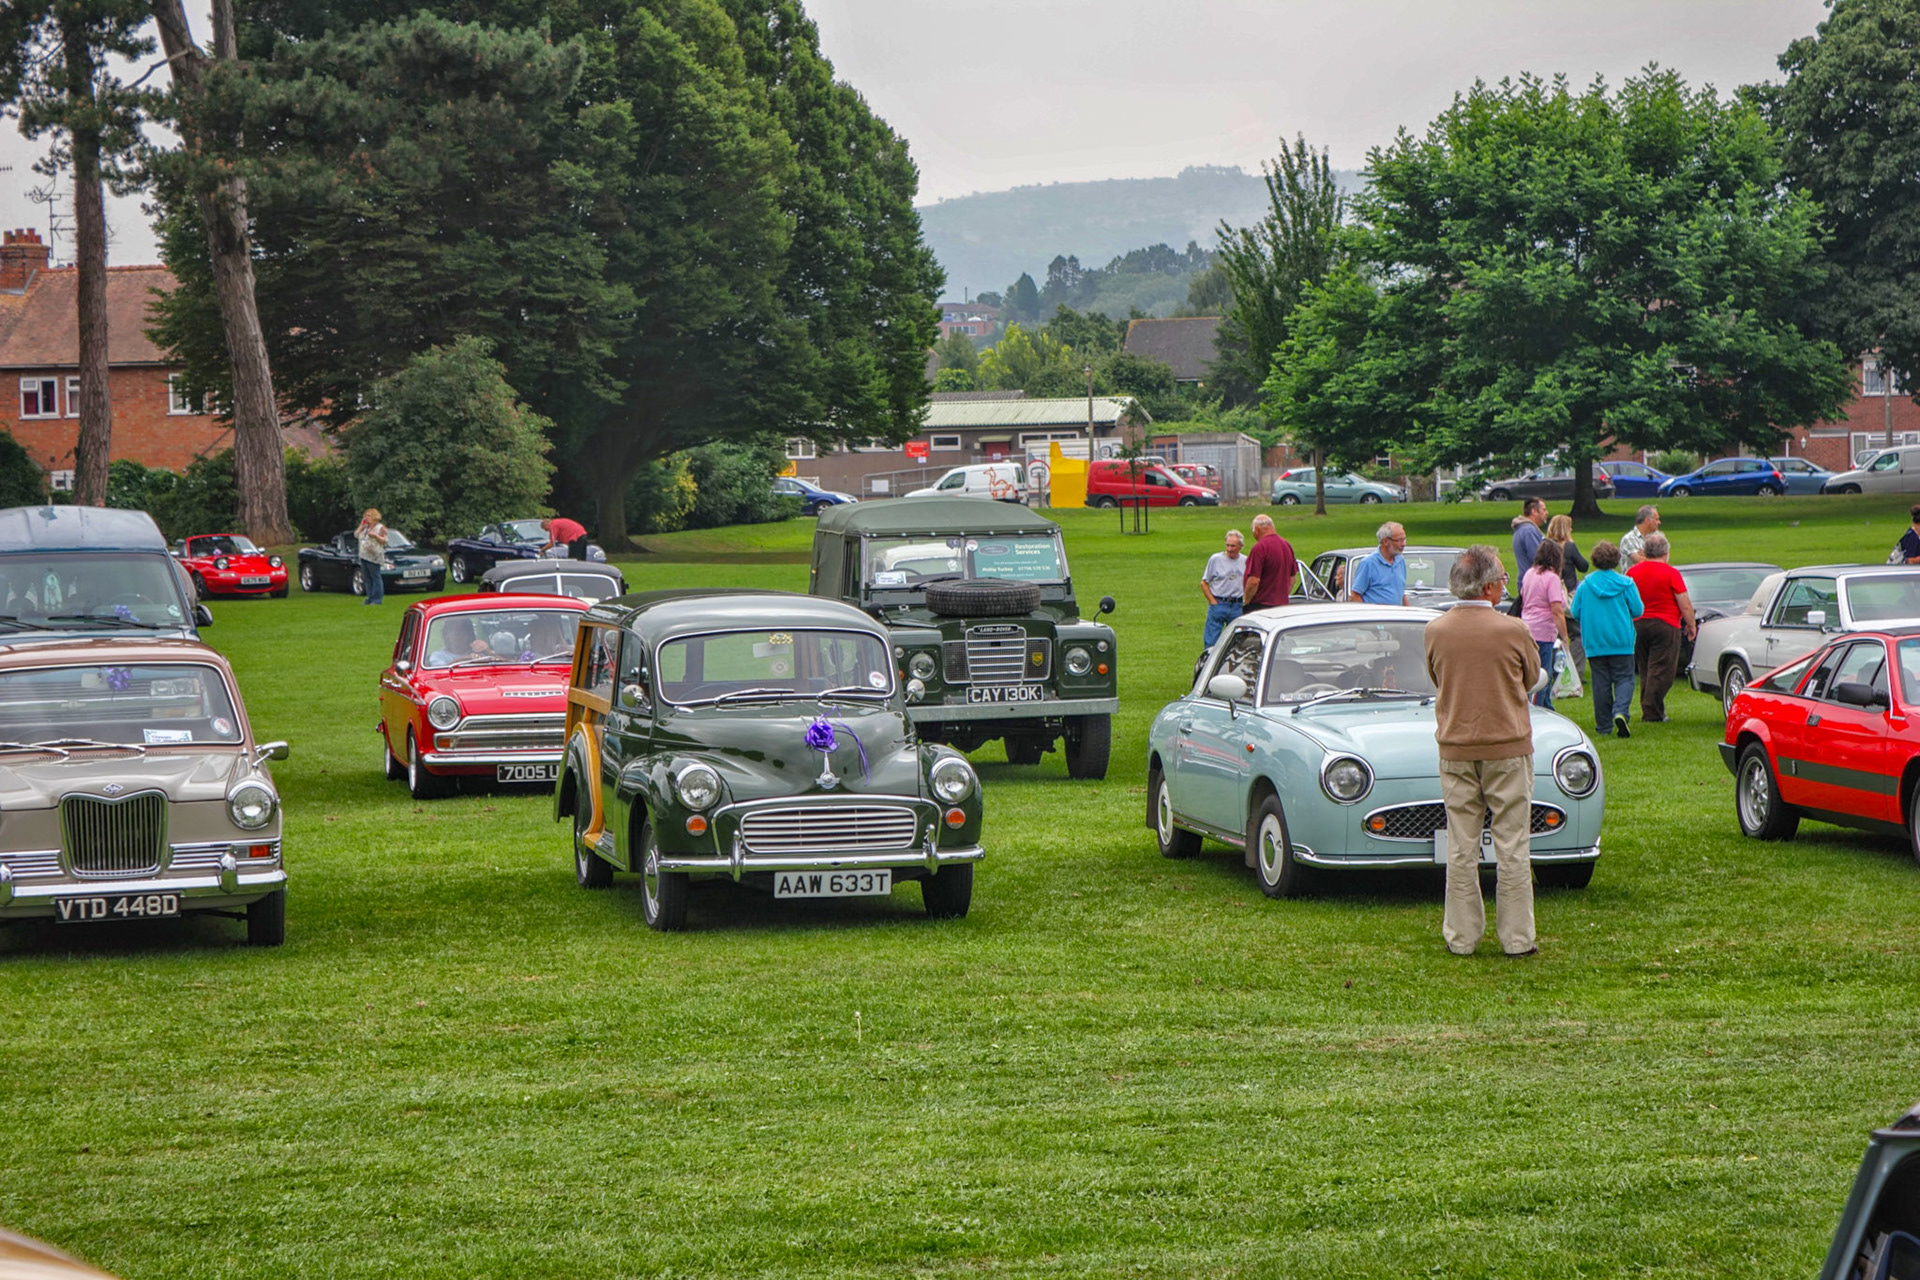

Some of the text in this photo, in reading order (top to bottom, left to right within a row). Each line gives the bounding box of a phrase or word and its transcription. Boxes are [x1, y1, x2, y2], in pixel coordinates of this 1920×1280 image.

[971, 686, 1039, 703] CAY 130K
[504, 765, 546, 780] 7005
[778, 873, 889, 895] AAW 633T
[58, 895, 178, 920] VTD 448D
